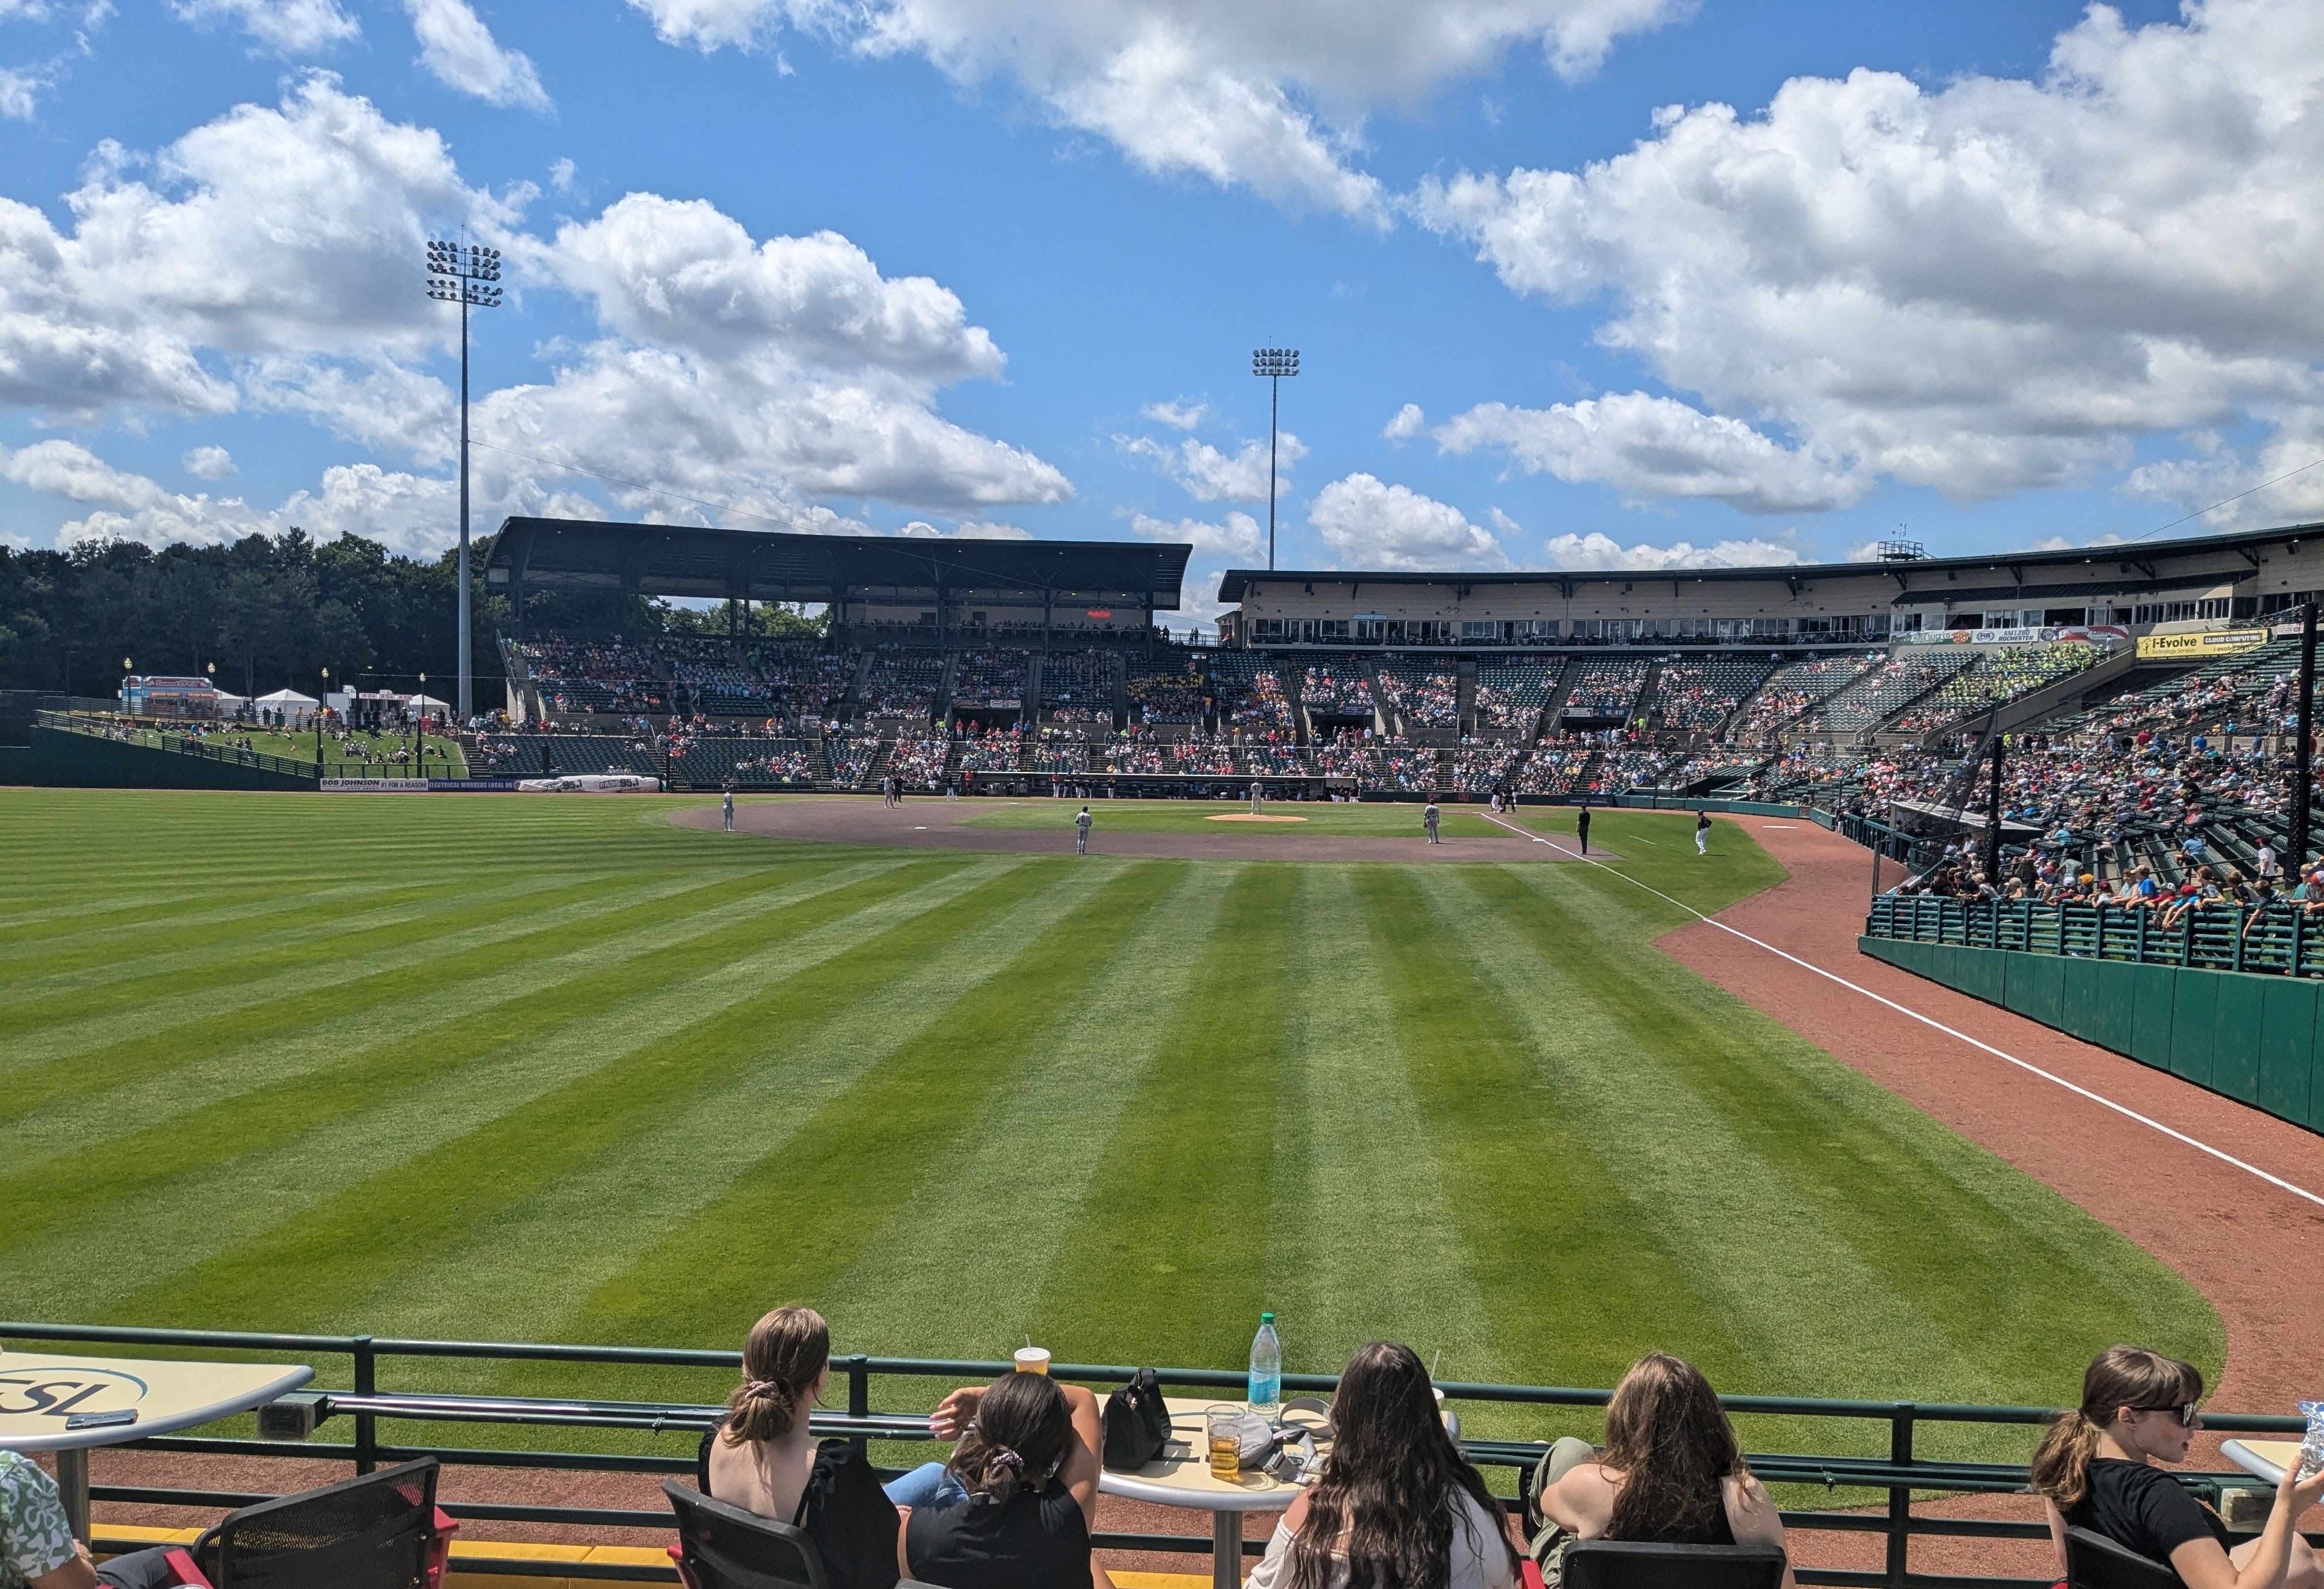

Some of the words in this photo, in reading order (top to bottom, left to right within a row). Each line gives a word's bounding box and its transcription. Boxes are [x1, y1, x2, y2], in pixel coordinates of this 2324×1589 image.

[562, 779, 583, 789] 95.1
[599, 780, 620, 789] RADIO
[620, 778, 639, 788] 95.1
